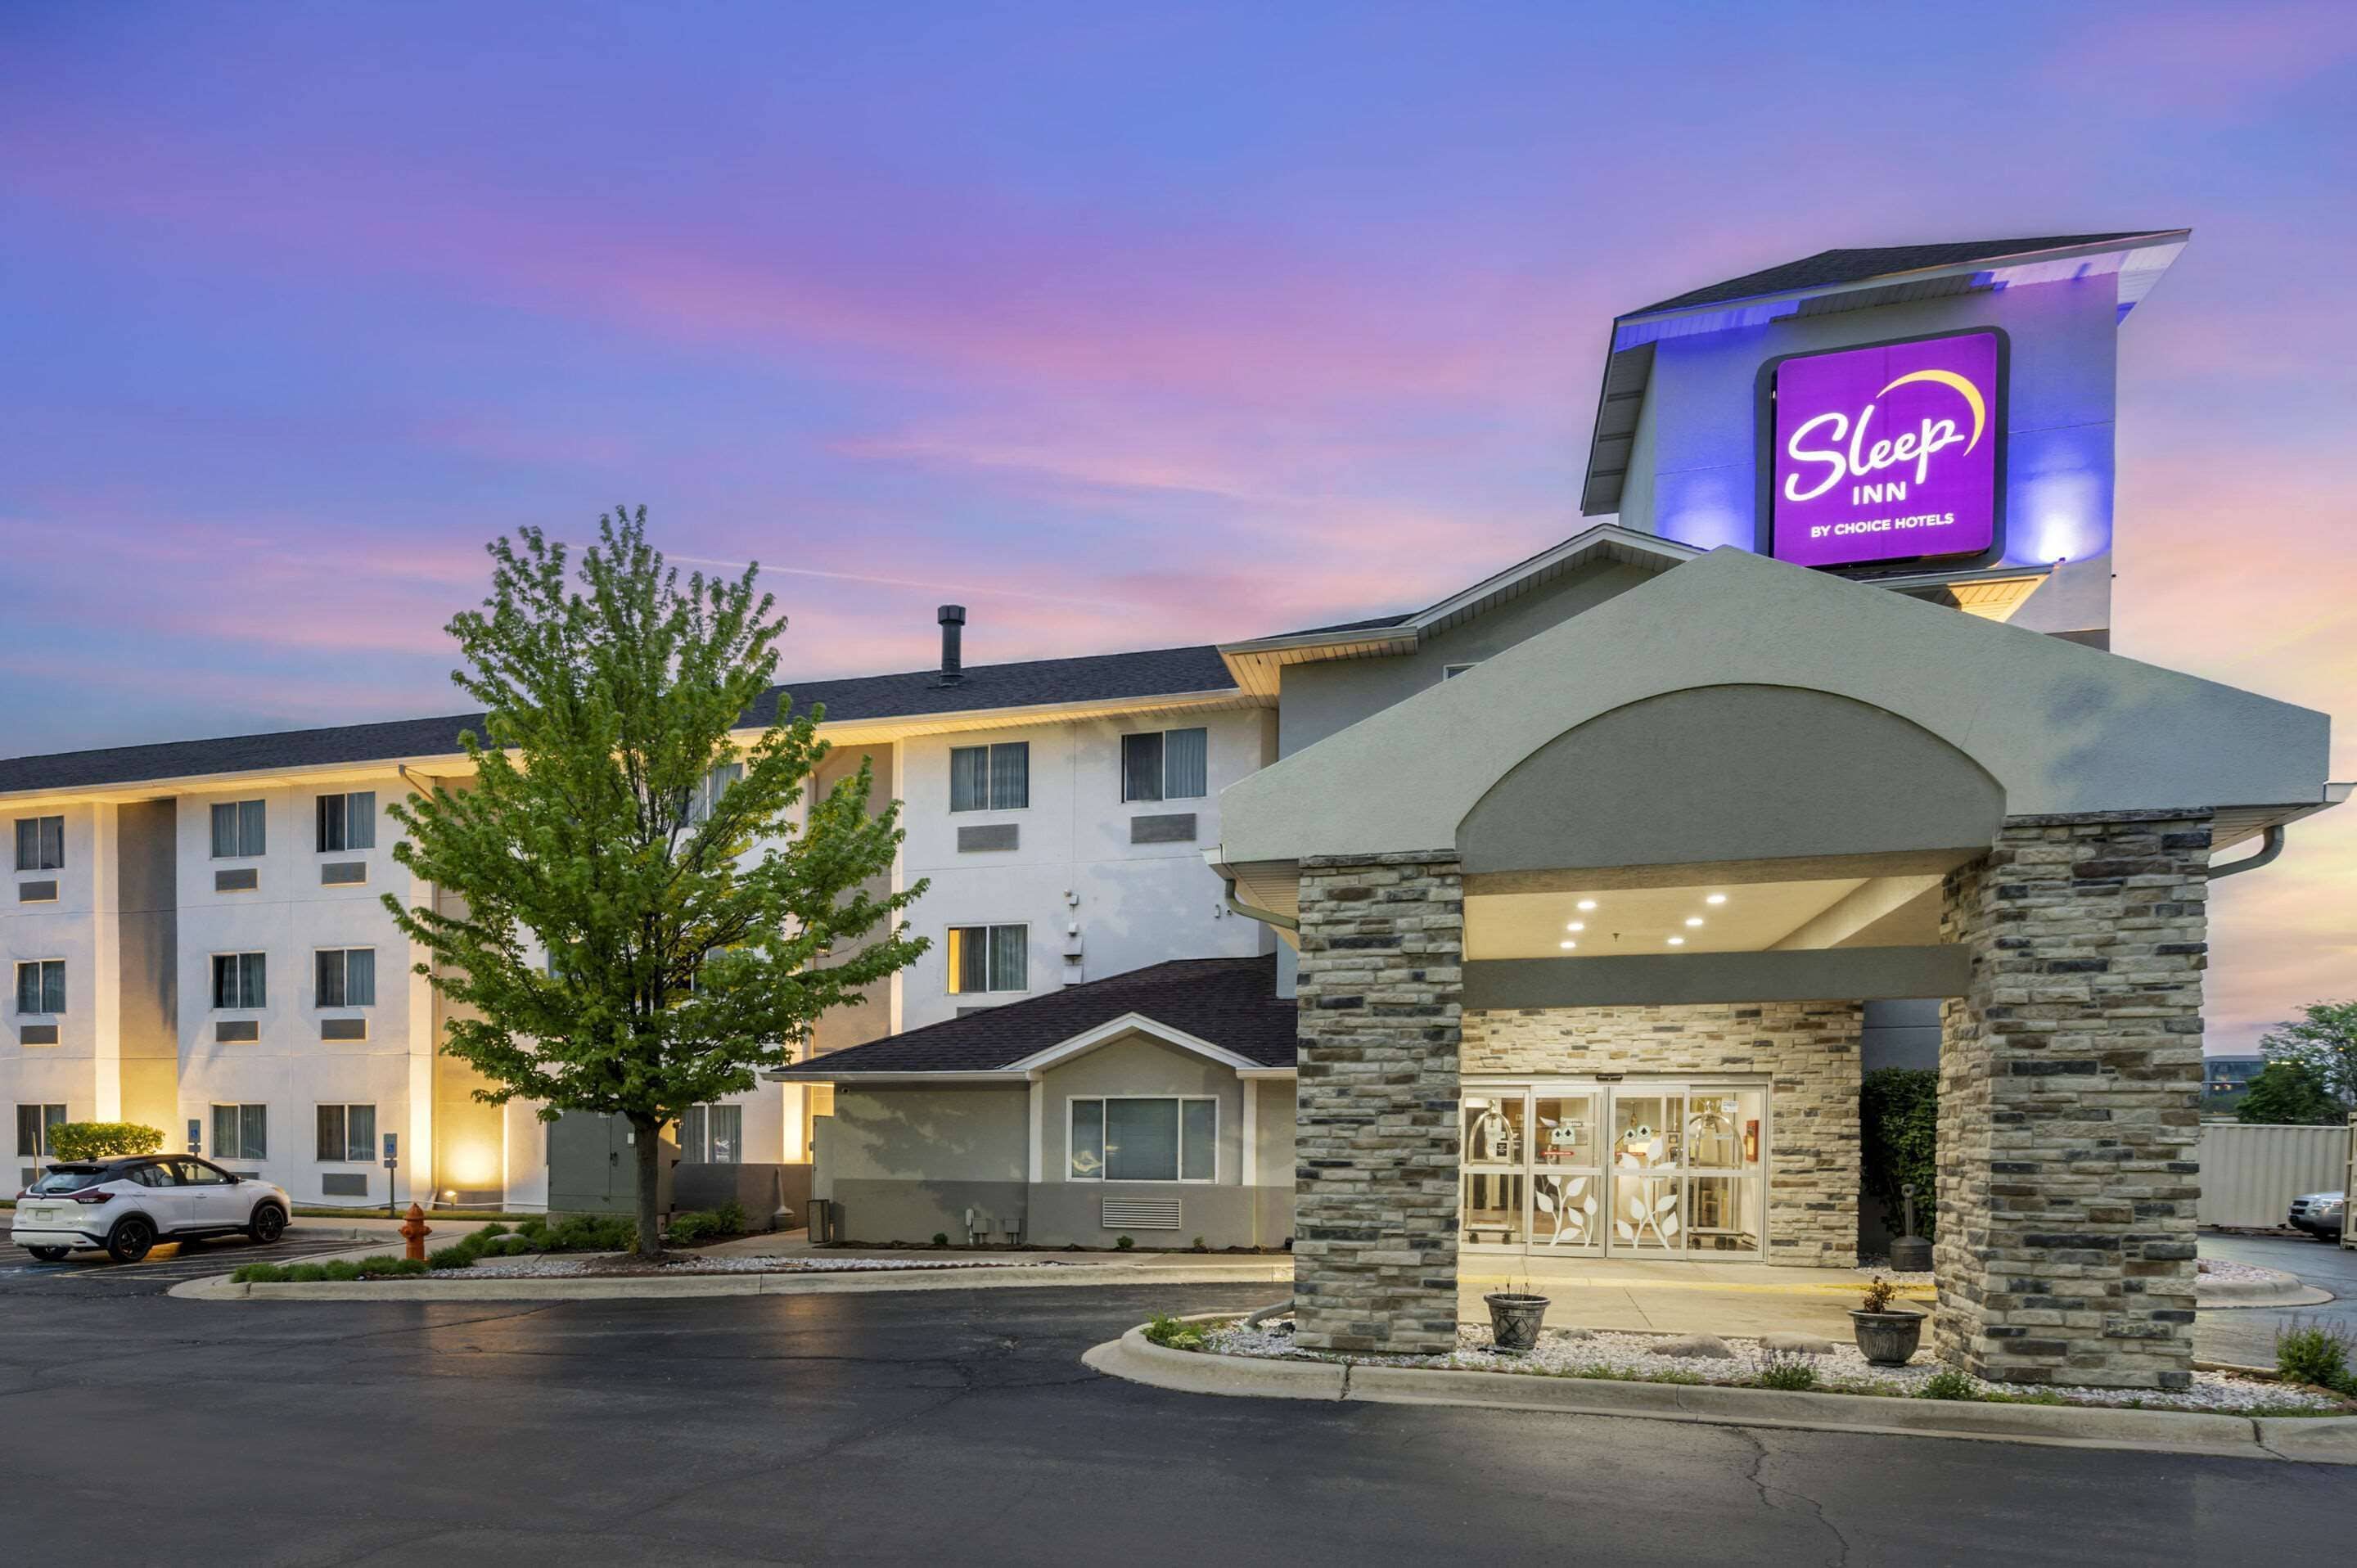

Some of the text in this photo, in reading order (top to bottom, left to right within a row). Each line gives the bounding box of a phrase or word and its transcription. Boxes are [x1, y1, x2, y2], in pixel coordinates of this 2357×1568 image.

[1785, 404, 1965, 502] Sleep
[1853, 481, 1907, 506] INN
[1810, 512, 1954, 538] BY CHOICE HOTELS
